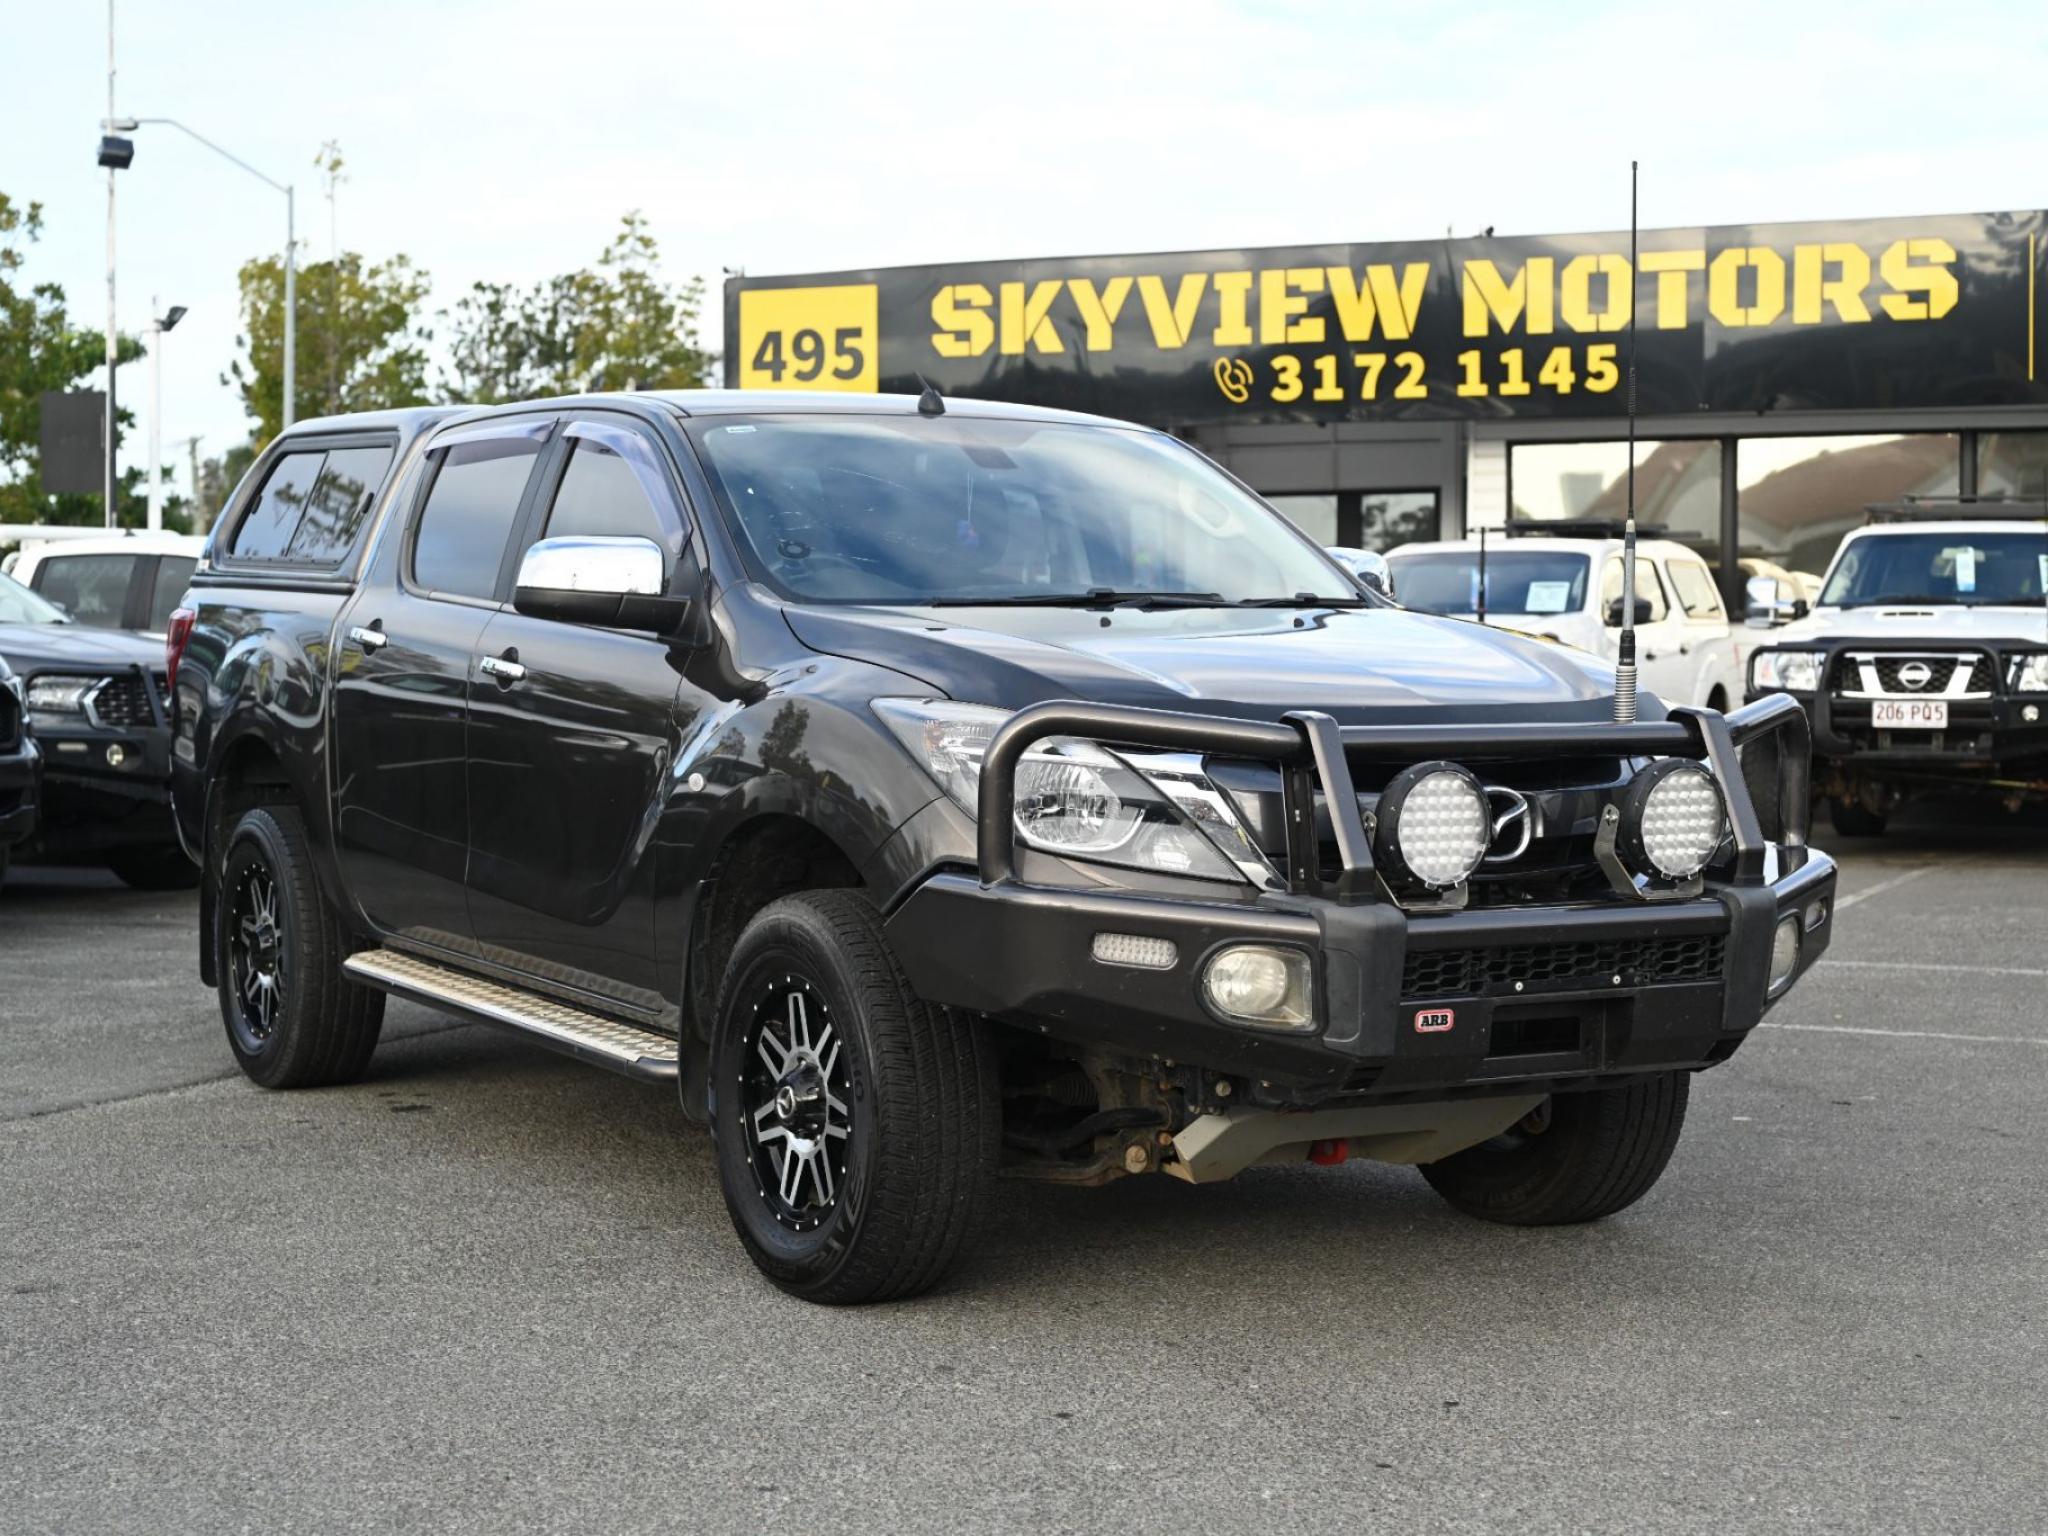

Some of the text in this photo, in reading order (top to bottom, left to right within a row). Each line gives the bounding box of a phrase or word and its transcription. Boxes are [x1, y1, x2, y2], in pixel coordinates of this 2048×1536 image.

[930, 236, 1959, 358] SKYVIEW MOTORS
[752, 327, 864, 382] 495
[1270, 343, 1619, 402] 3172 1145
[1876, 704, 1905, 721] 206
[1420, 1014, 1449, 1026] ARB
